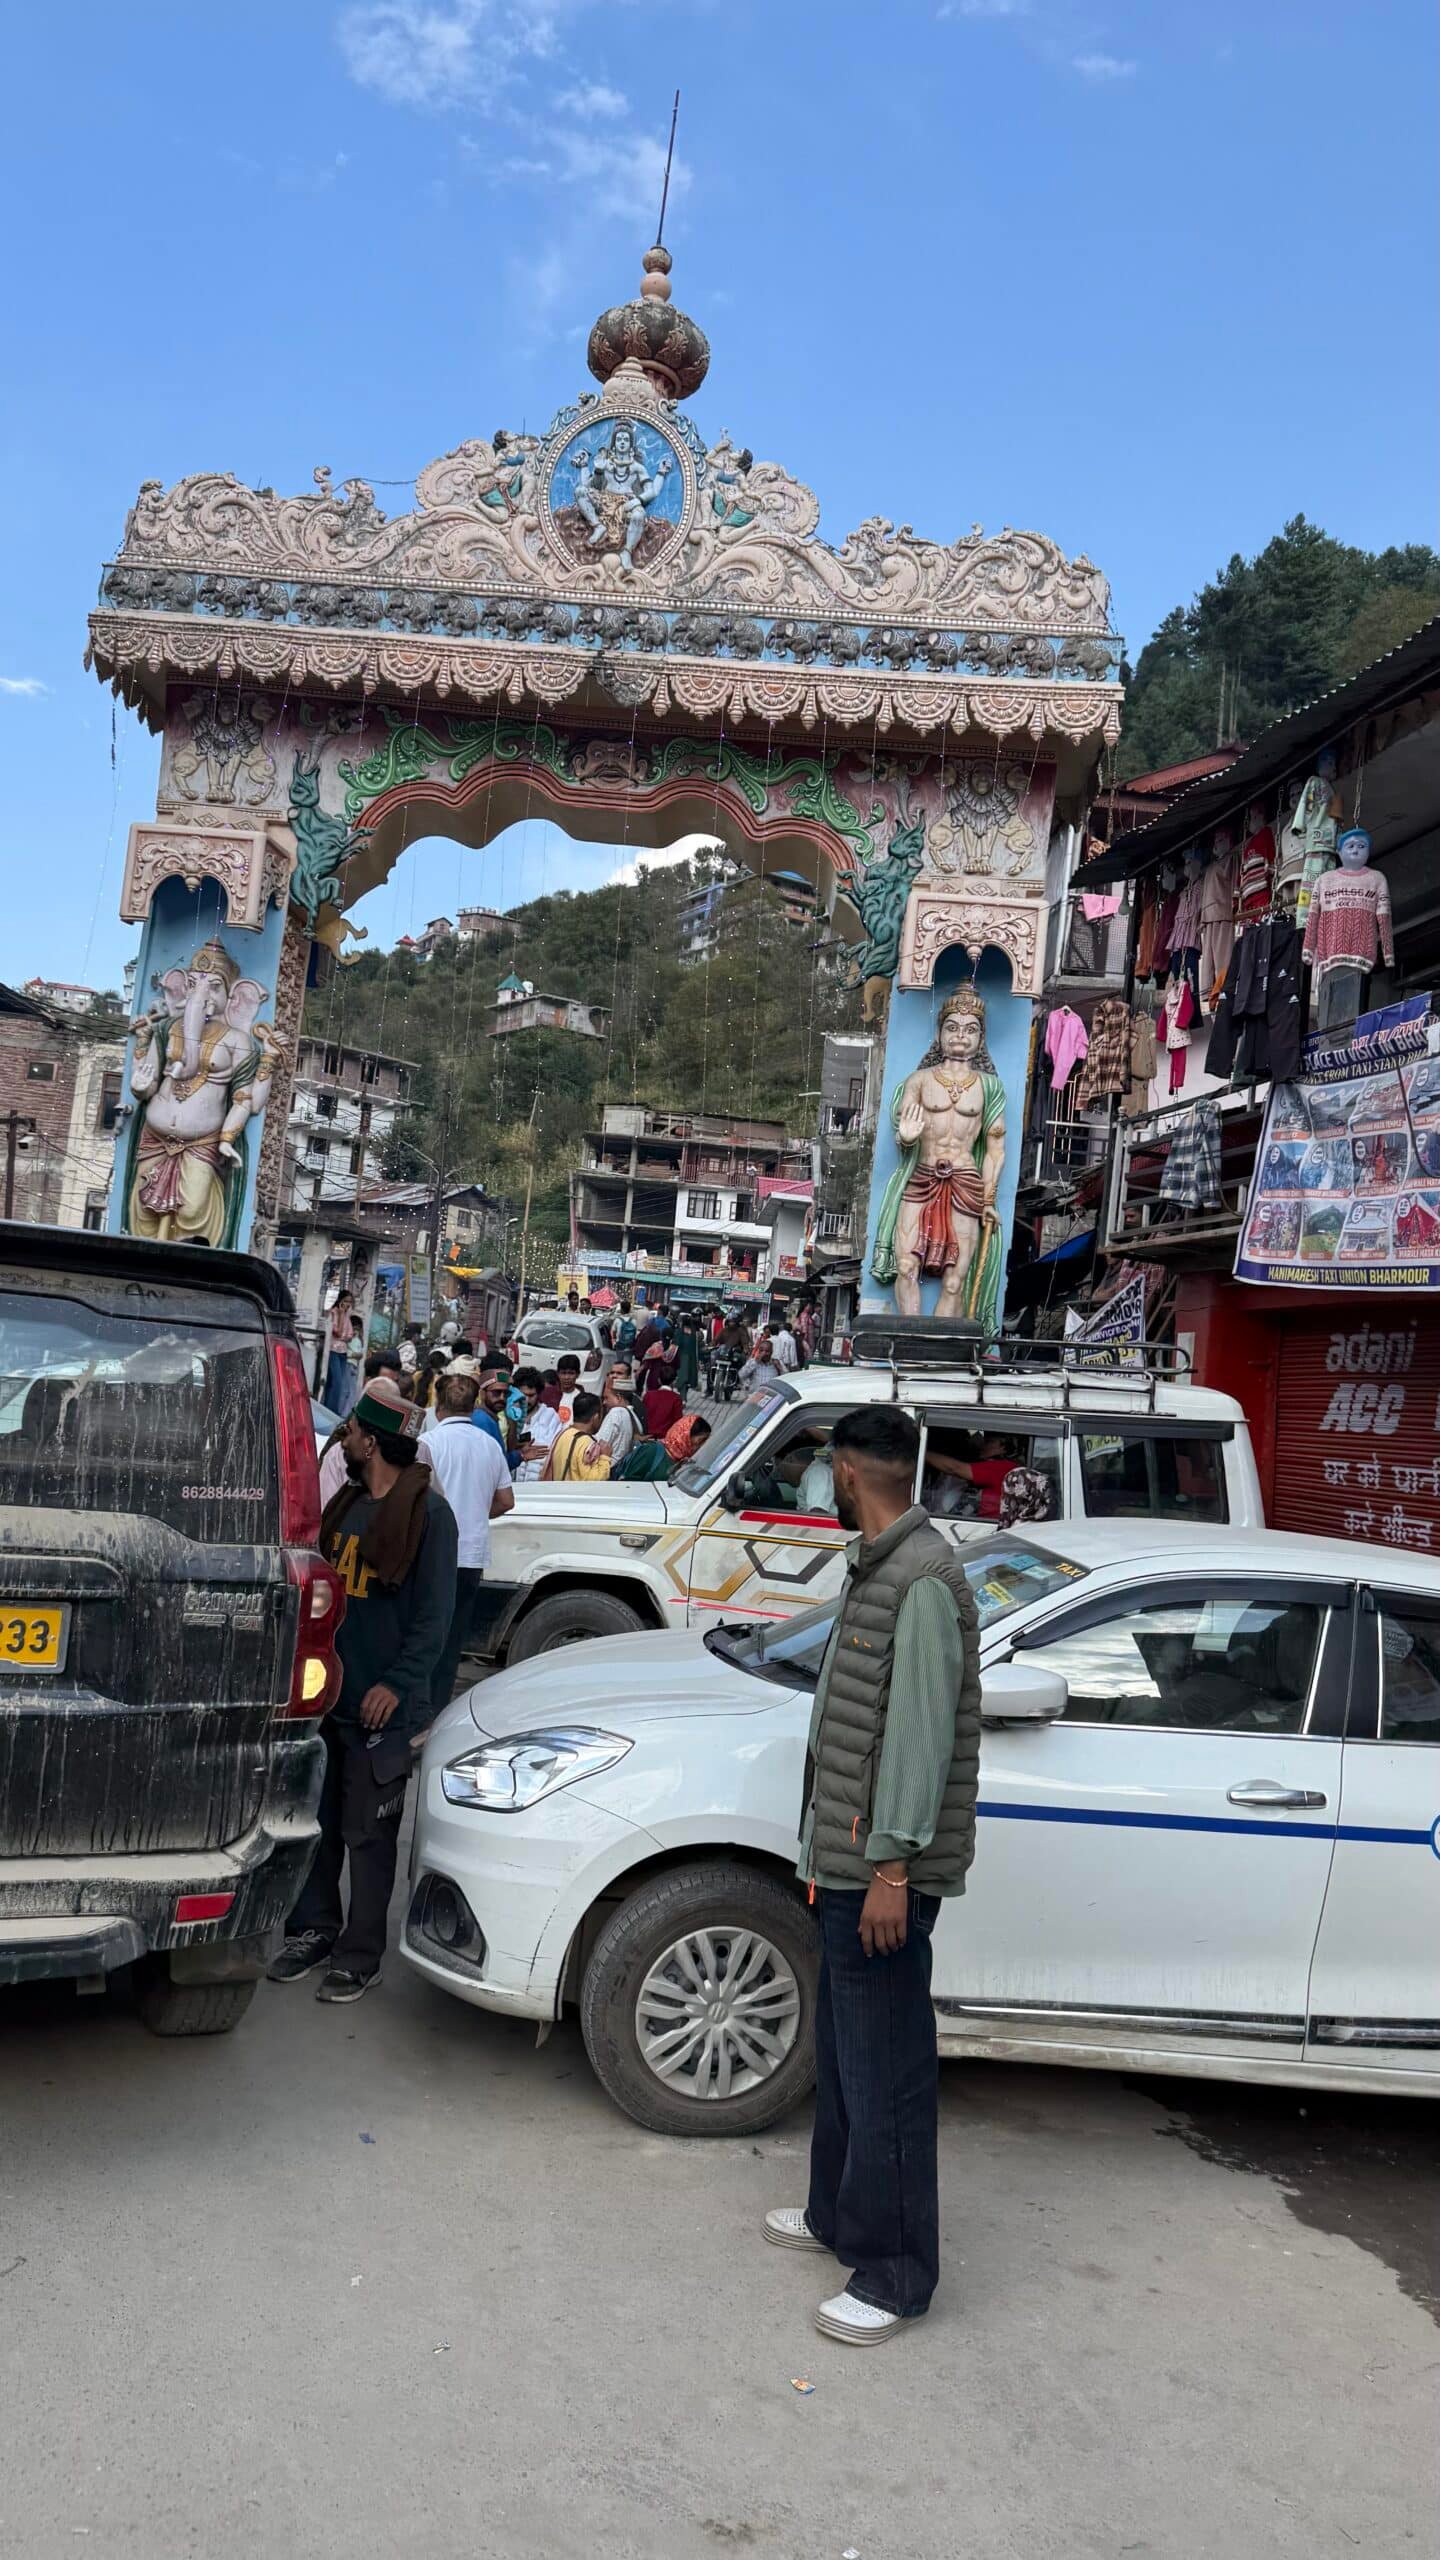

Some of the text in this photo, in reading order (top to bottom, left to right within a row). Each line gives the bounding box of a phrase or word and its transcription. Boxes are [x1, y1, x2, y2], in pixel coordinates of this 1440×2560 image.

[1396, 1027, 1428, 1051] BHA
[1351, 1060, 1372, 1076] TAXI
[1268, 1264, 1430, 1284] MANIMAHESH TAXI UNION BHARMOUR
[1325, 1319, 1417, 1374] adani
[1318, 1383, 1406, 1435] ACC
[181, 1485, 265, 1500] 8628844429
[1055, 1562, 1086, 1578] TAXI
[0, 1618, 50, 1653] 33
